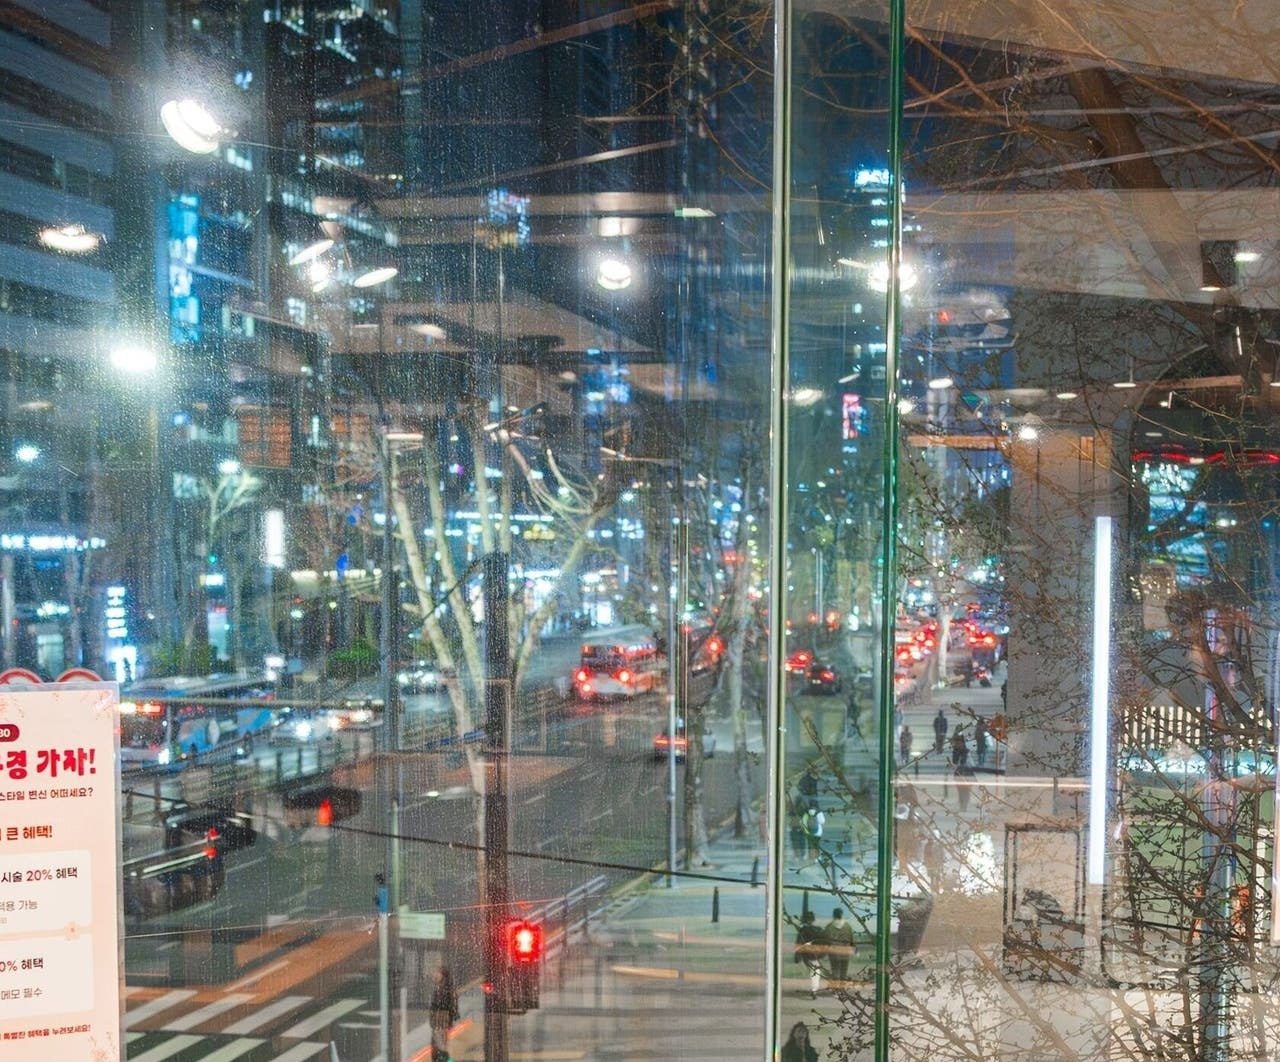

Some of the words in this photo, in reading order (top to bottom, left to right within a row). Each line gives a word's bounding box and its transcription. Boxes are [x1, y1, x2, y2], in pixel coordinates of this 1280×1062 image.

[36, 748, 96, 778] 가자!
[28, 790, 48, 800] 변신
[50, 787, 94, 799] 어떠세요?
[6, 827, 19, 841] 큰
[22, 825, 53, 839] 혜택!
[1, 871, 23, 883] 시술
[26, 869, 53, 882] 20%
[56, 867, 78, 879] 혜택
[18, 899, 38, 911] 가능
[21, 957, 44, 970] 혜택
[1, 989, 21, 1001] 메모
[23, 987, 43, 999] 필수
